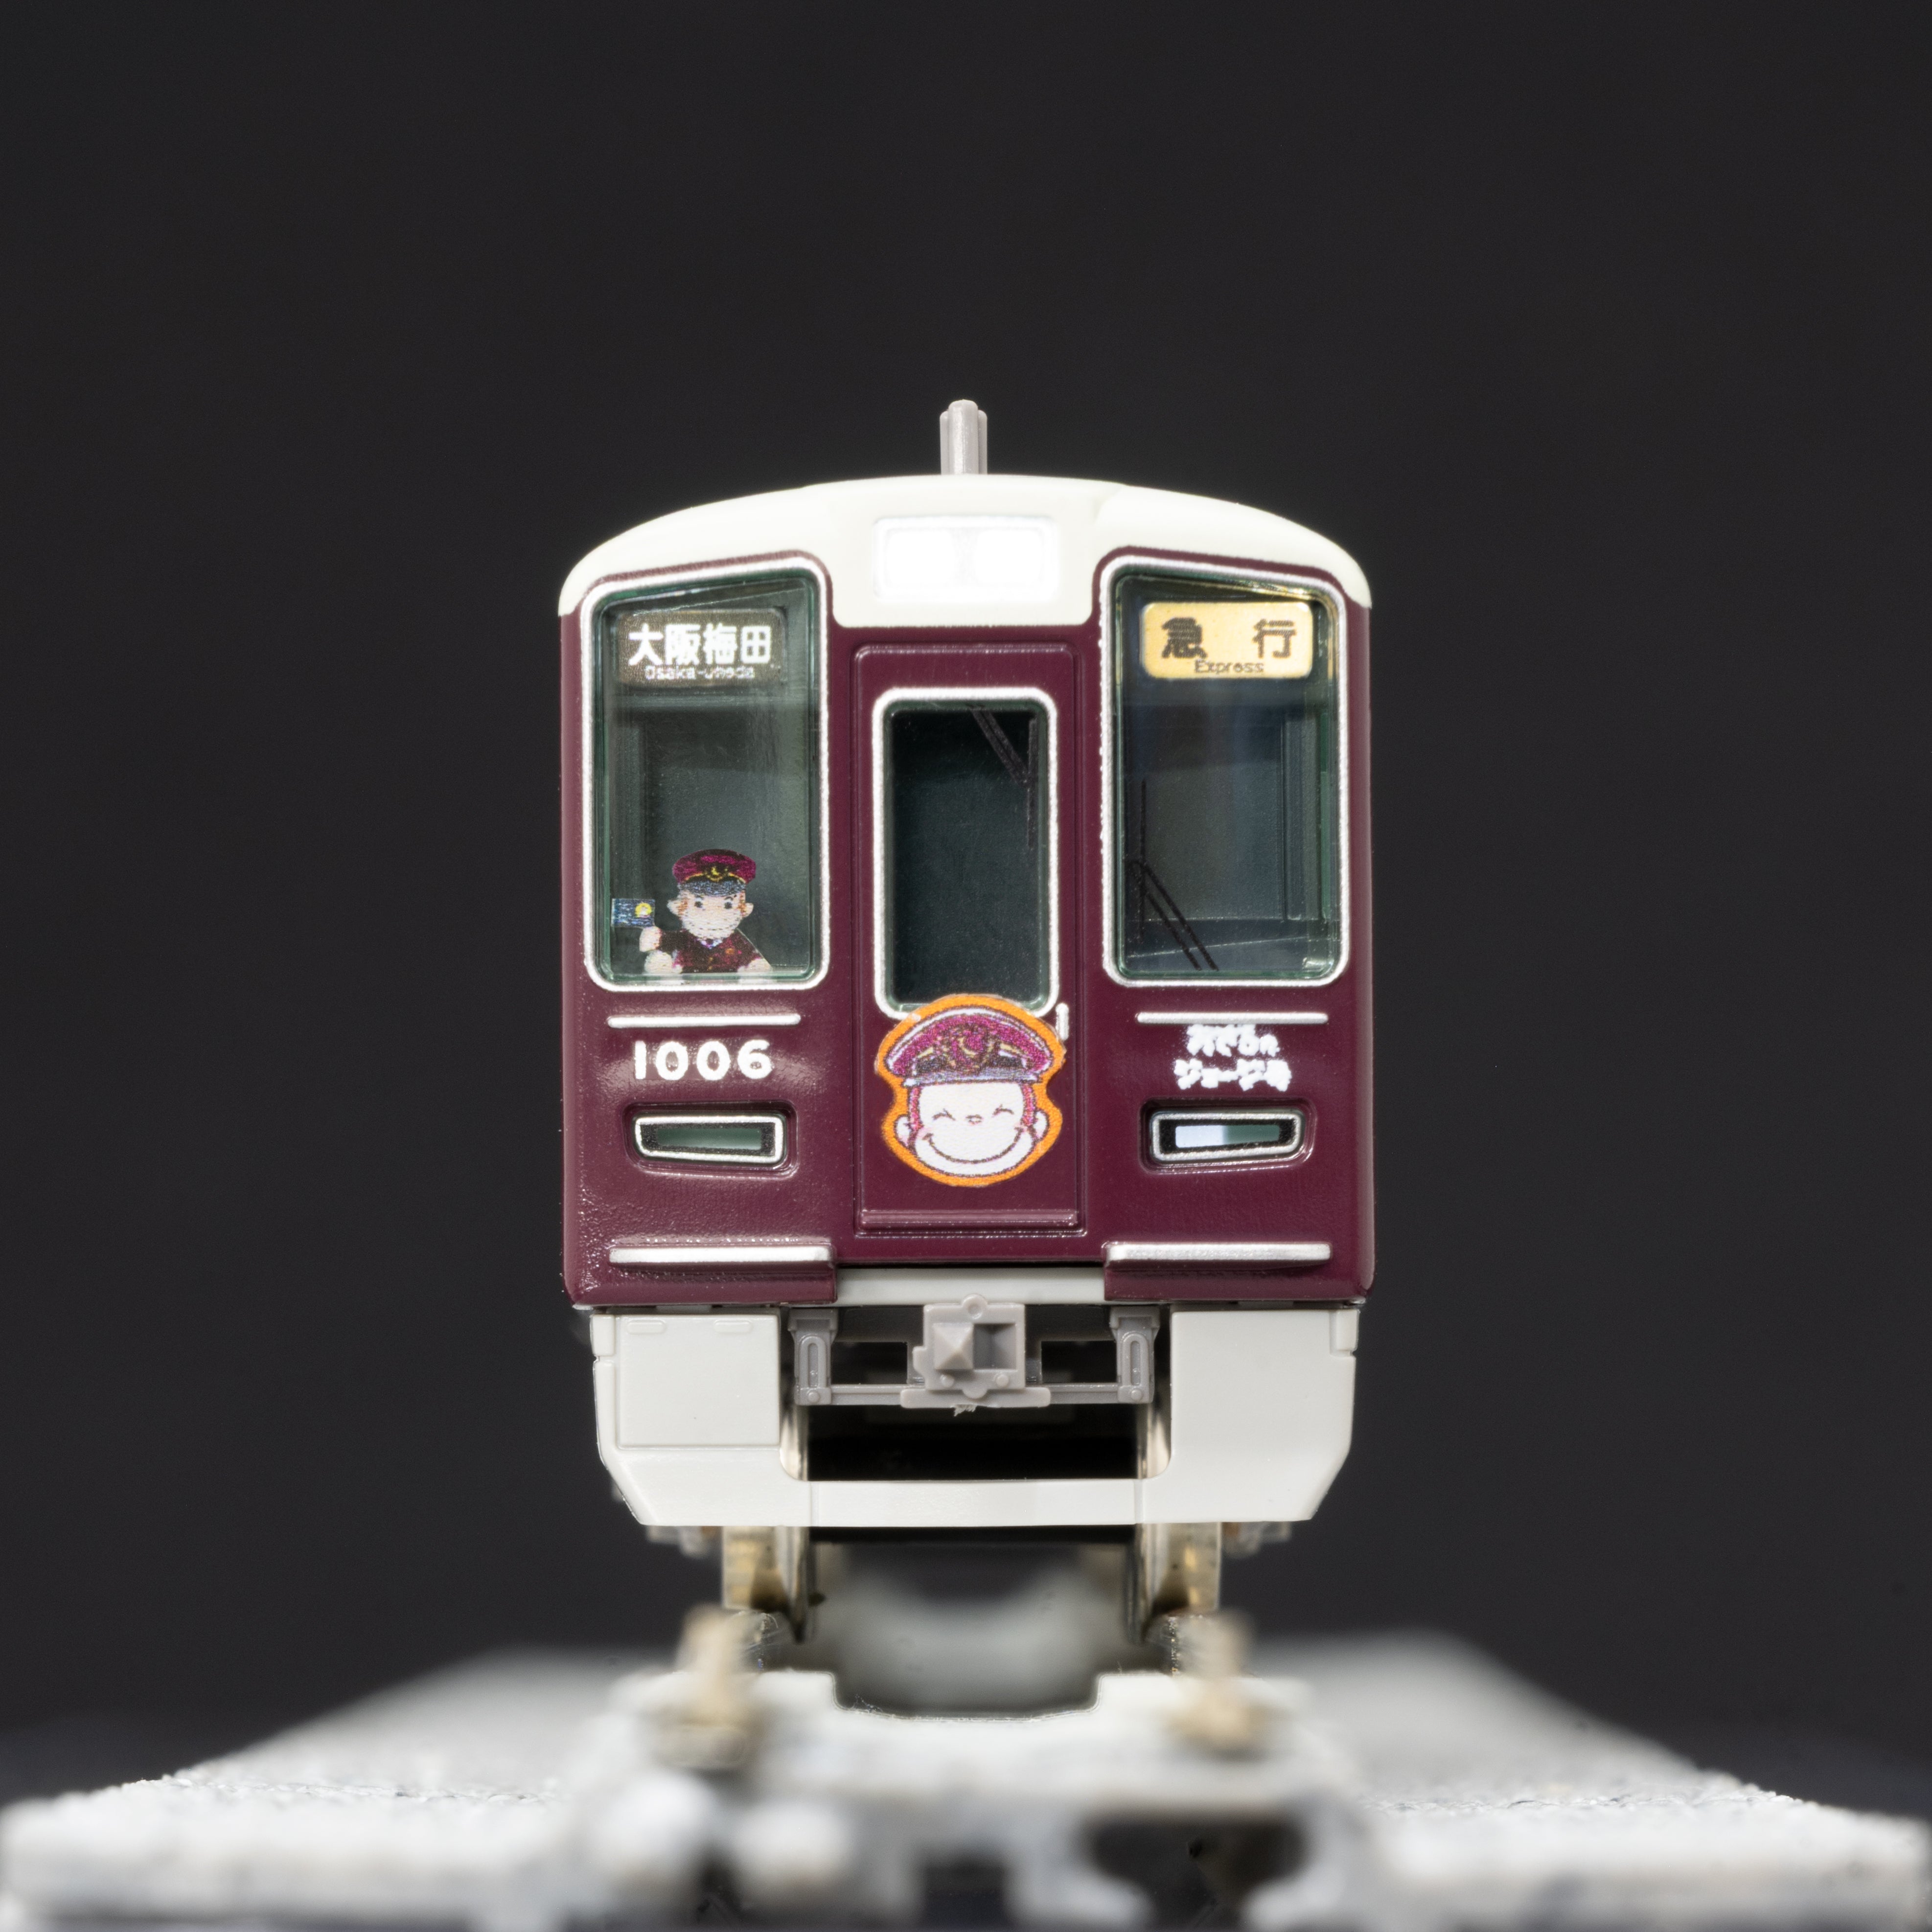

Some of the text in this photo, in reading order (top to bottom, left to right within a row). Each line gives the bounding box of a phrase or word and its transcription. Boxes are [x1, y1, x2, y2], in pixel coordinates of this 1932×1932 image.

[628, 623, 771, 665] 大阪梅田
[1194, 659, 1265, 674] Express
[635, 1039, 774, 1080] 1006
